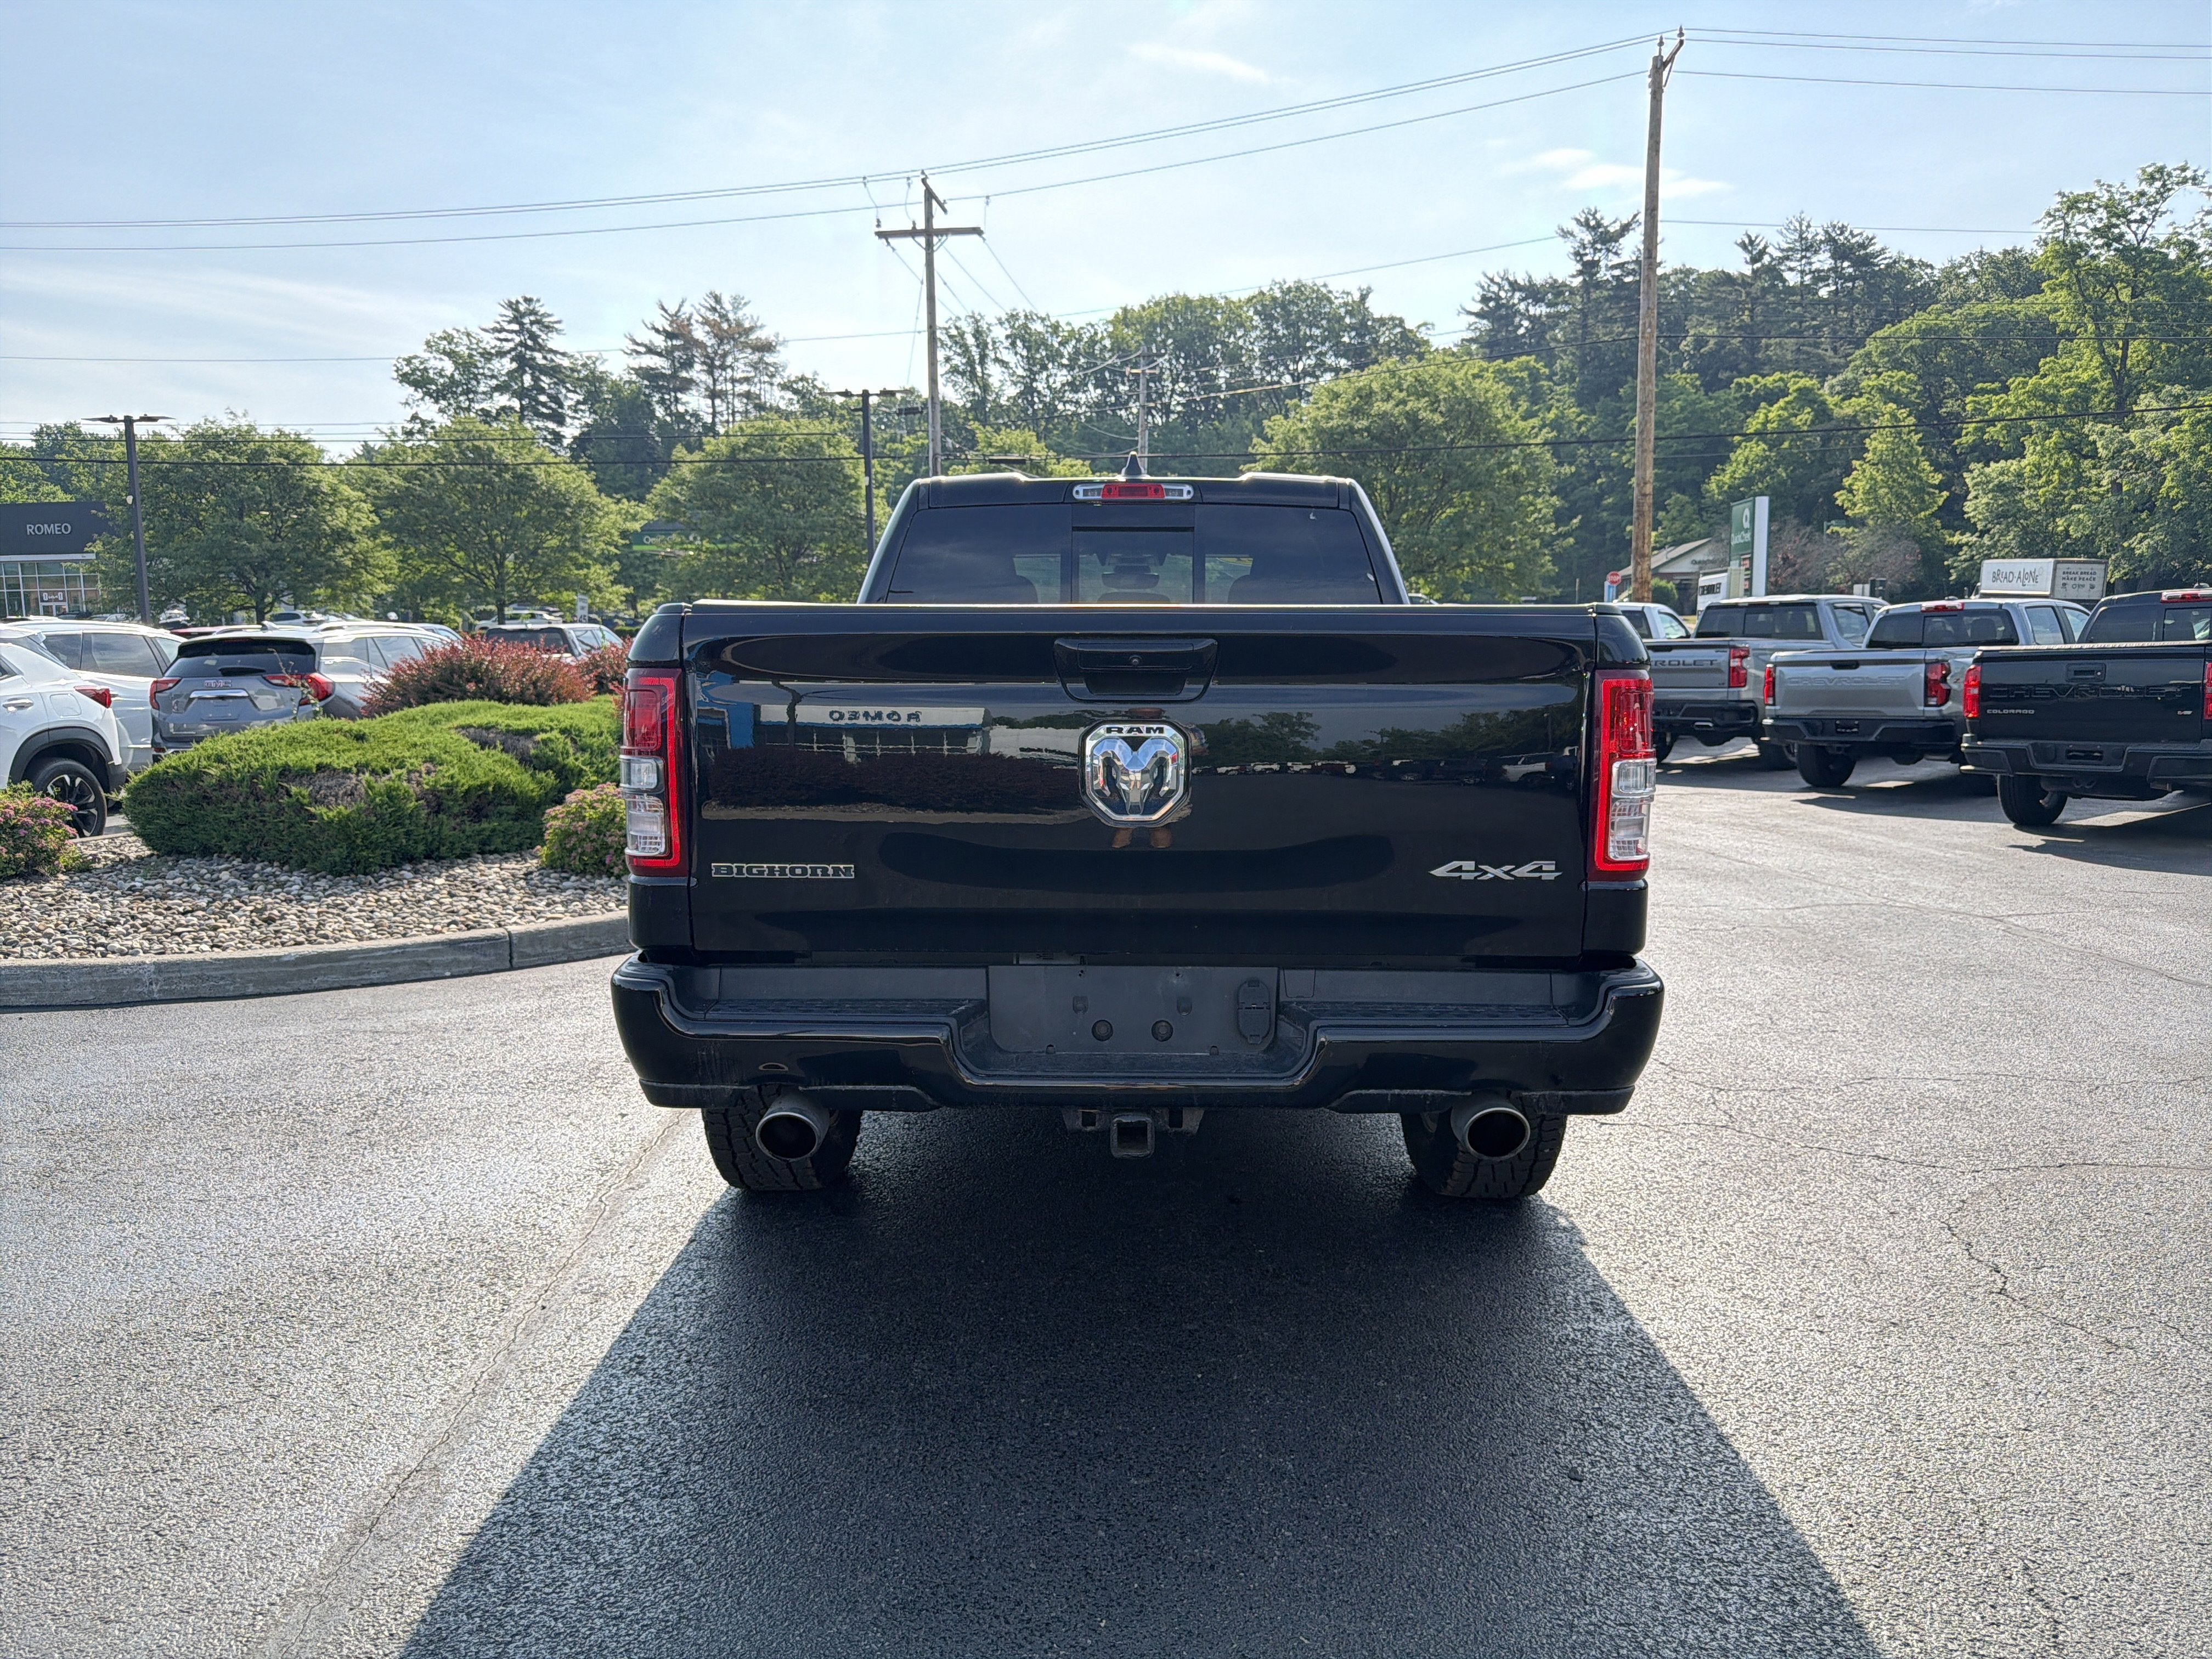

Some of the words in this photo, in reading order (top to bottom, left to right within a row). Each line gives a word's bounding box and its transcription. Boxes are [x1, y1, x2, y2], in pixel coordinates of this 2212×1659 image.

[26, 523, 71, 535] ROMEO
[1786, 676, 1905, 685] CHEVROLET
[1989, 686, 2191, 697] CHEVROLET
[1428, 861, 1563, 880] 4x4
